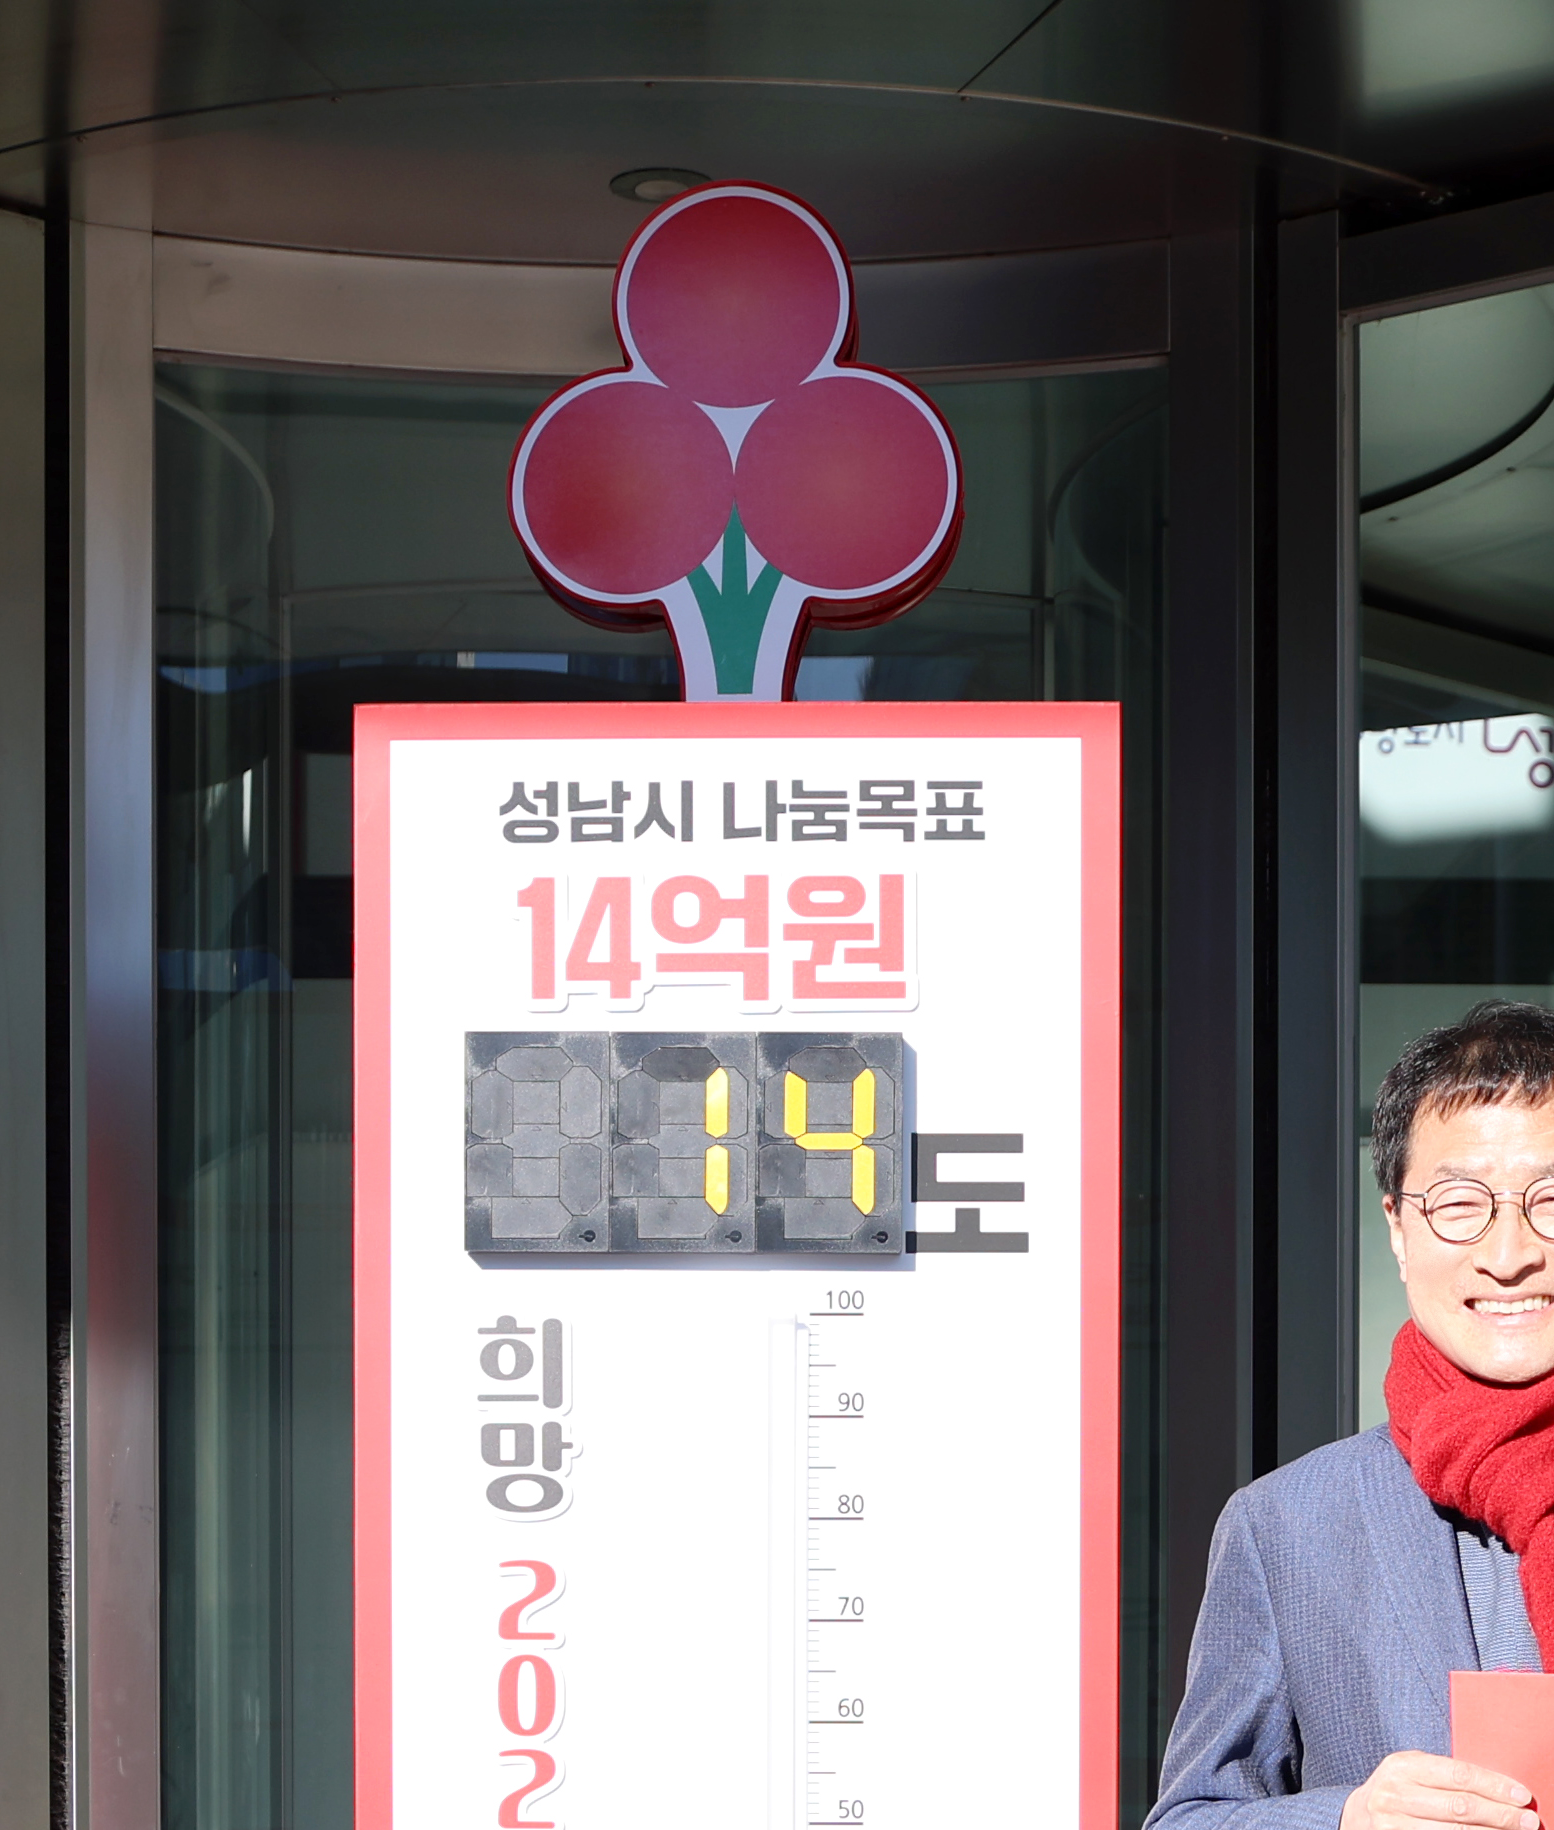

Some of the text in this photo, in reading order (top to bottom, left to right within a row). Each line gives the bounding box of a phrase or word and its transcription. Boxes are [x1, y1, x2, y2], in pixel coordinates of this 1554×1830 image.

[499, 779, 986, 844] 성남시 나눔목표
[516, 873, 908, 1001] 14억원
[705, 1067, 876, 1216] 14
[905, 1132, 1029, 1254] 도
[825, 1290, 865, 1310] 100
[837, 1393, 865, 1412] 90
[477, 1315, 574, 1513] 희망
[837, 1495, 865, 1514] 80
[837, 1597, 865, 1616] 70
[837, 1699, 865, 1718] 60
[837, 1800, 865, 1819] 50
